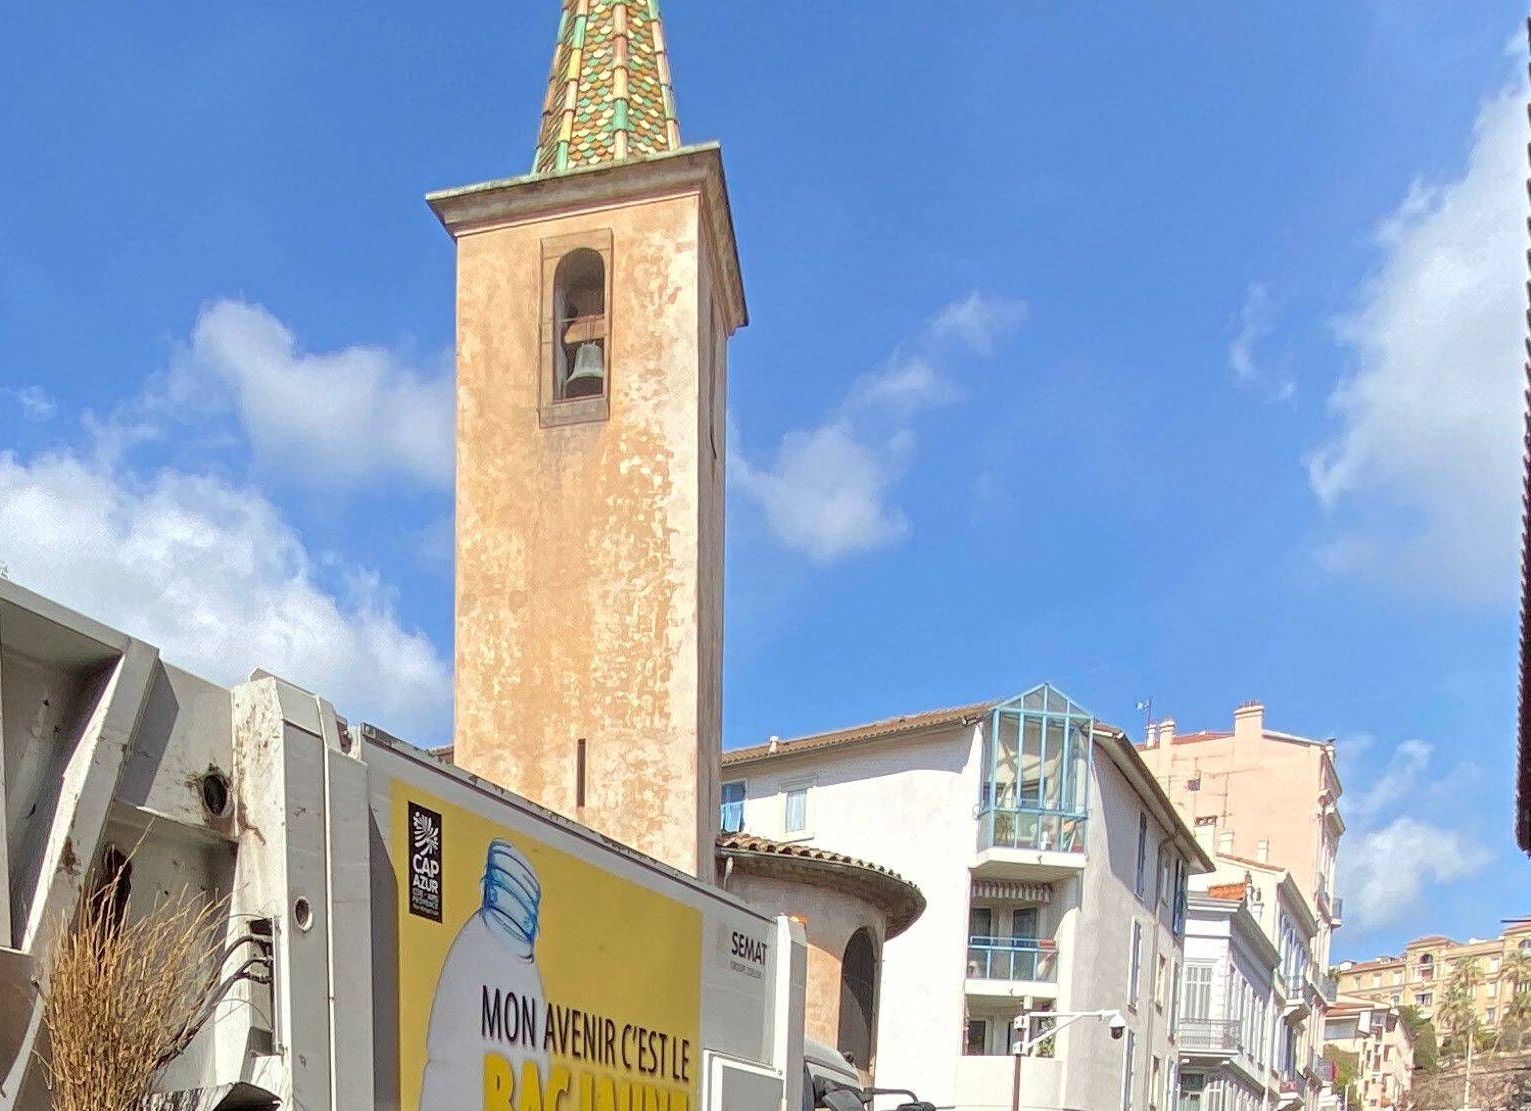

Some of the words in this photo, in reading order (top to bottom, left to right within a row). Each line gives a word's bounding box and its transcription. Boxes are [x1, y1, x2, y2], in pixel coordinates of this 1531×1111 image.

[413, 853, 440, 878] CAP
[412, 873, 439, 894] AZUR
[731, 931, 767, 965] SEMAT
[481, 984, 536, 1048] MON
[543, 1002, 616, 1068] AVENIR
[621, 1023, 668, 1079] C'EST
[672, 1036, 690, 1082] LE
